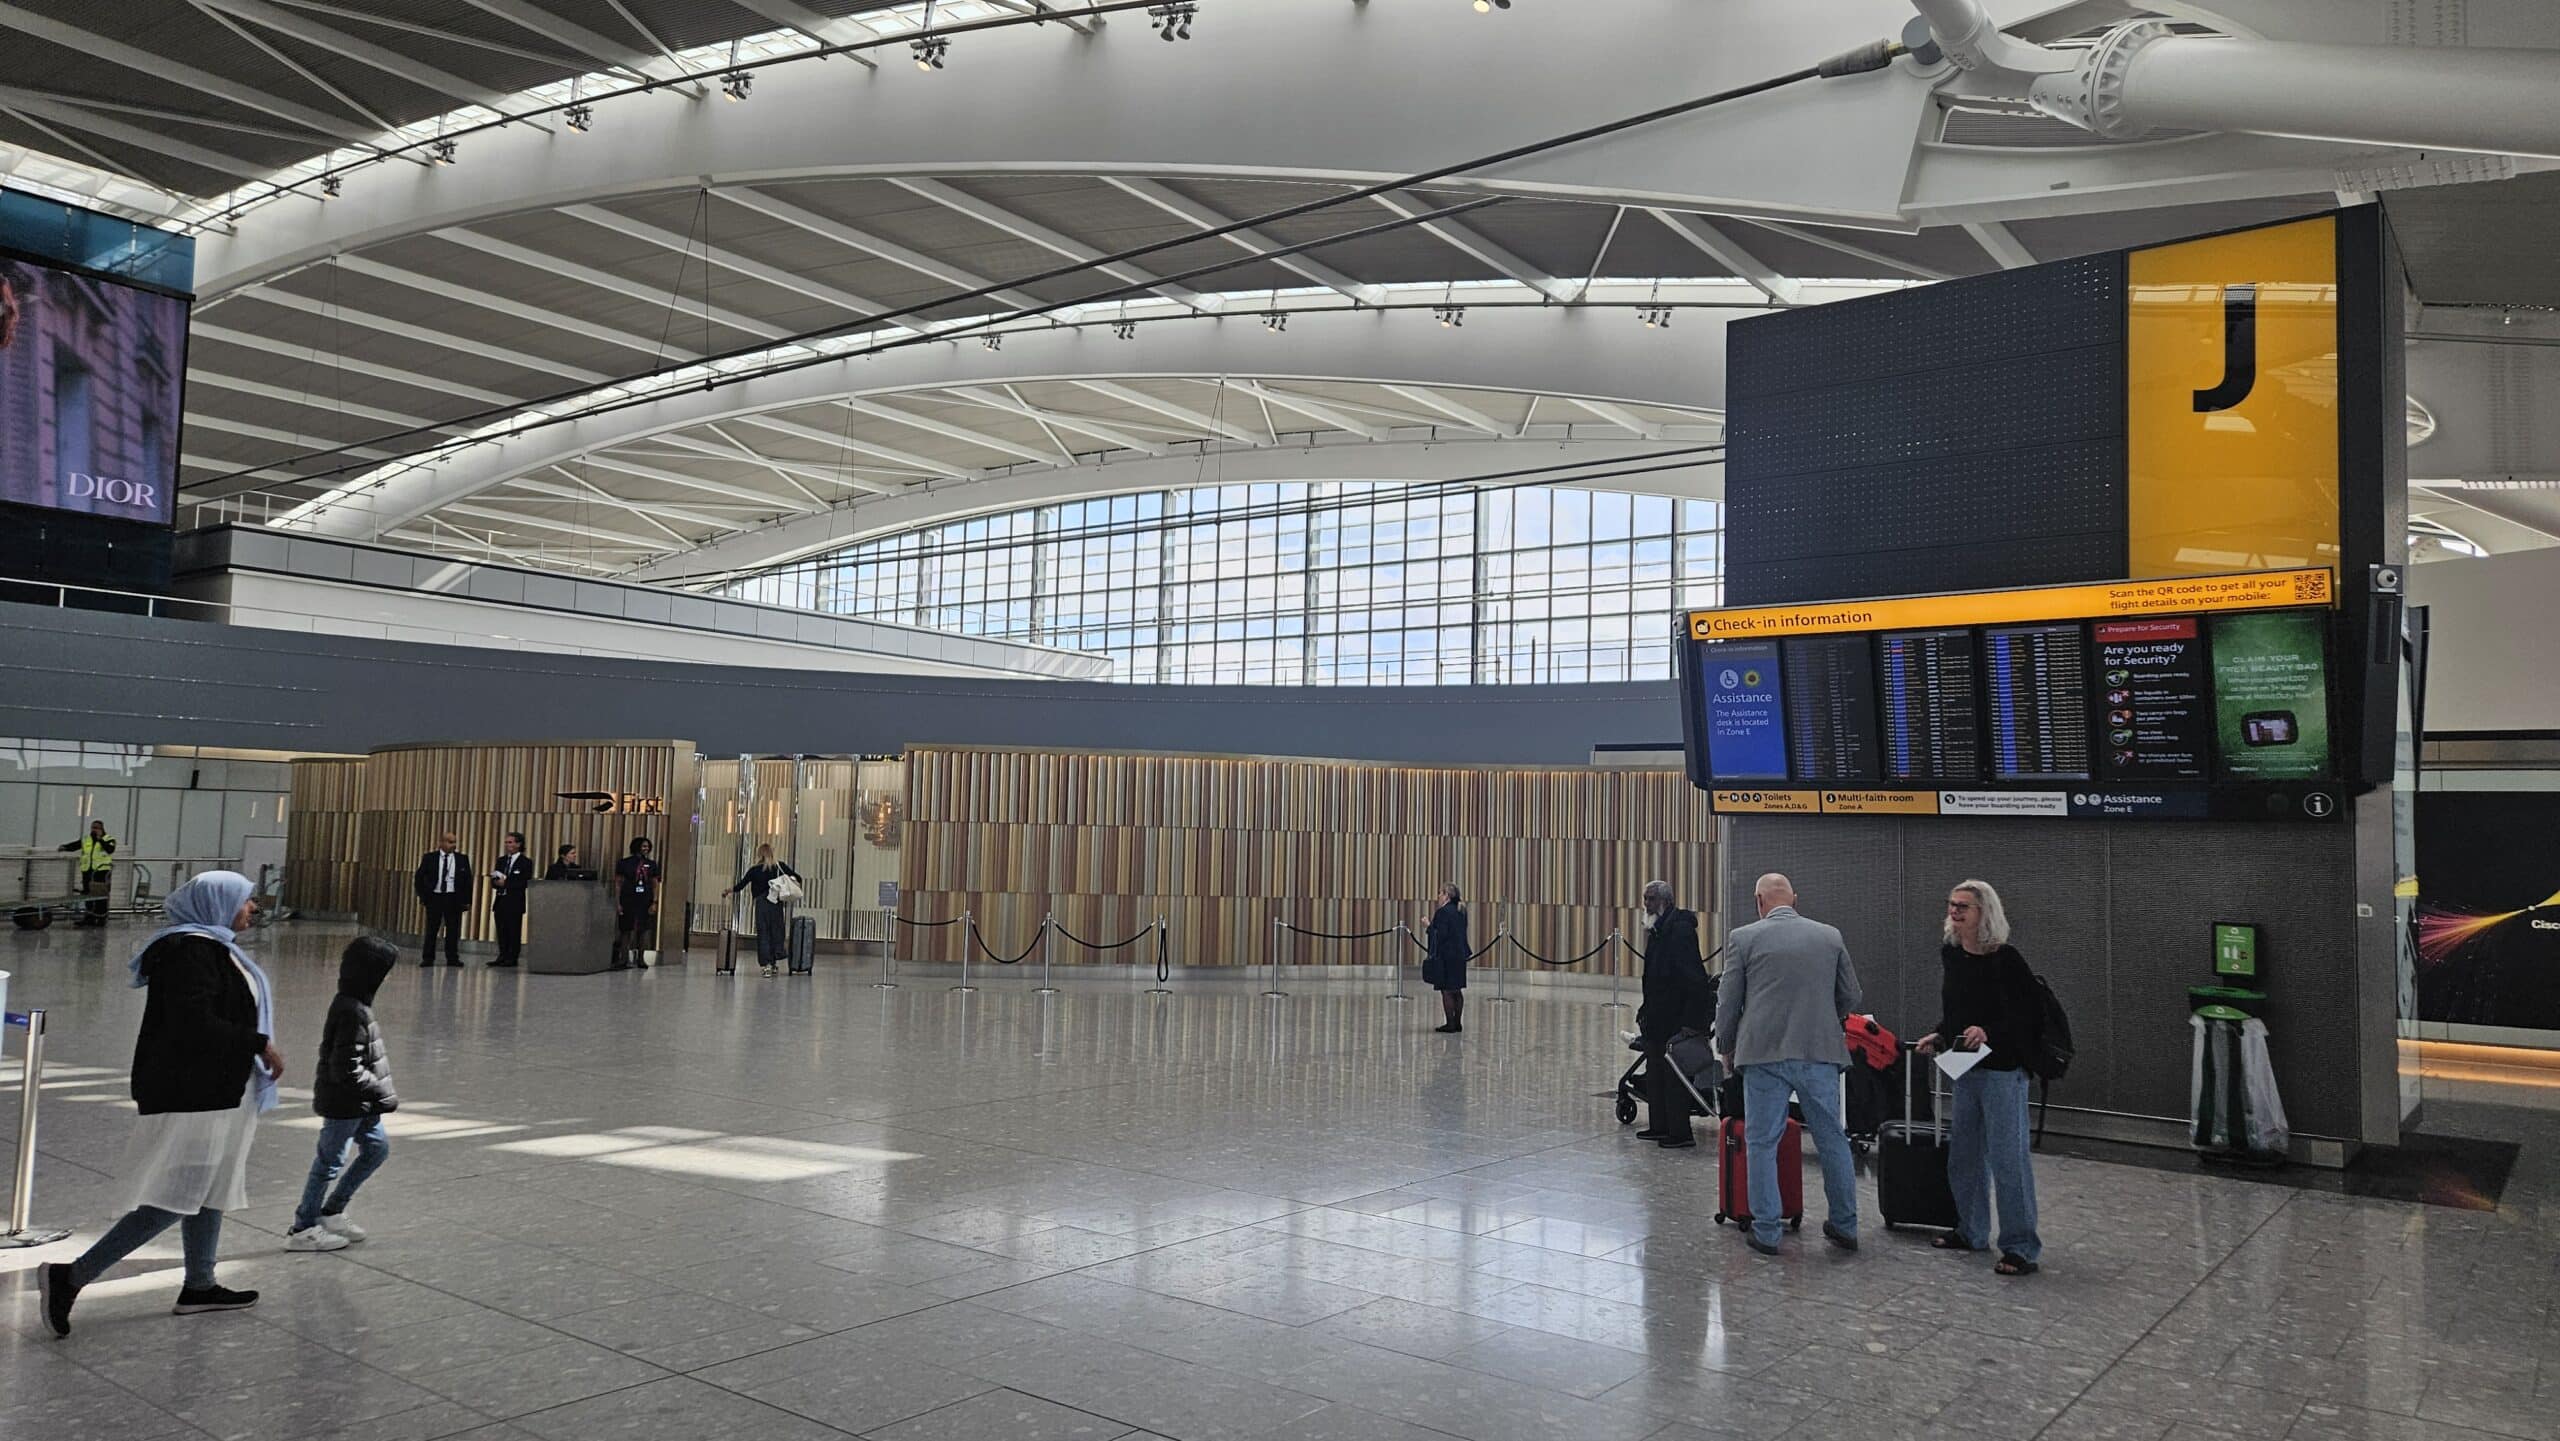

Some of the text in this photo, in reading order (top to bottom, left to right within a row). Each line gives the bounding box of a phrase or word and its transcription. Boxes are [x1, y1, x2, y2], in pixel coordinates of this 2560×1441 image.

[2193, 283, 2256, 413] J
[67, 472, 157, 508] DIOR
[2109, 579, 2287, 599] Scan the QR code to get all your
[2111, 591, 2271, 611] flight details on your mobile:
[1714, 611, 1872, 631] Check-in information
[2149, 624, 2181, 632] Security
[2103, 643, 2184, 656] Are you ready
[2104, 654, 2177, 666] for Security?
[1712, 693, 1772, 704] Assistance
[1731, 709, 1768, 717] Assistance
[1716, 719, 1732, 727] desk
[1741, 718, 1769, 726] located
[1717, 728, 1724, 736] in
[1726, 728, 1744, 736] Zone
[1763, 793, 1792, 801] Toilets
[1838, 793, 1886, 802] Multi-faith
[2104, 794, 2162, 804] Assistance
[622, 793, 663, 813] First
[2104, 805, 2133, 813] Zone E
